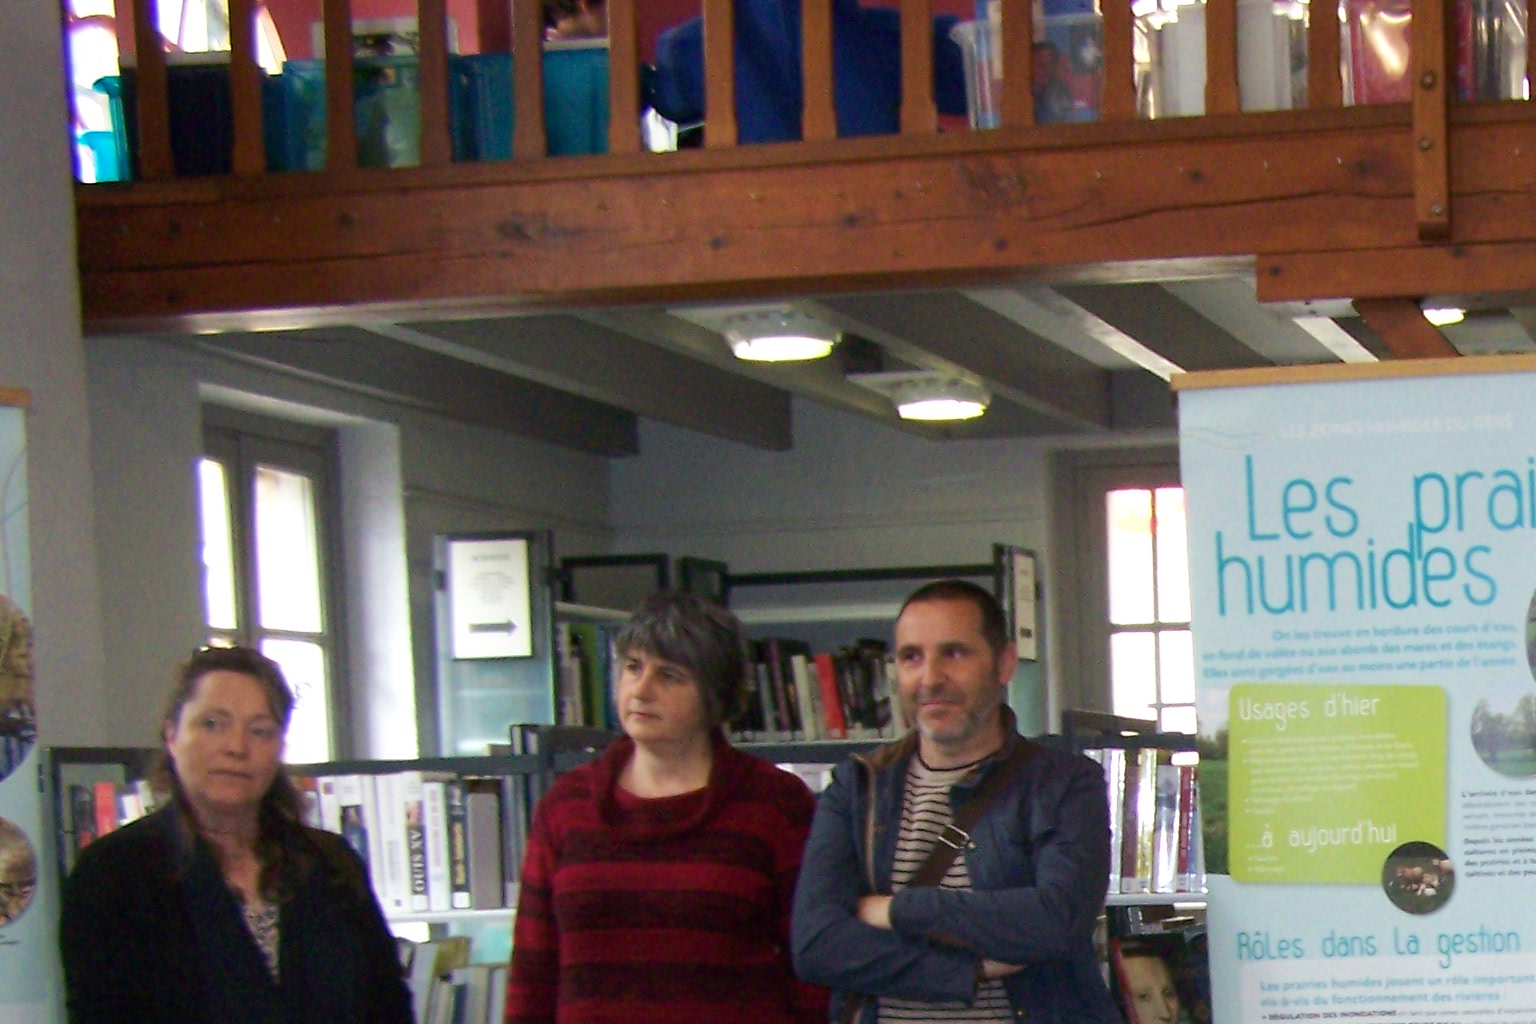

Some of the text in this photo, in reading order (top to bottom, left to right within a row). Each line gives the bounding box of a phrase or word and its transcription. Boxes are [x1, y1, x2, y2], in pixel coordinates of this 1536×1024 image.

[1245, 453, 1360, 541] Les
[1214, 522, 1499, 617] humides
[1239, 692, 1381, 732] Usages d'hier
[1288, 817, 1397, 854] aujourd'hui
[1237, 930, 1304, 961] Rôles
[1321, 928, 1377, 959] dans
[1394, 928, 1420, 956] la
[1437, 924, 1521, 969] gestion
